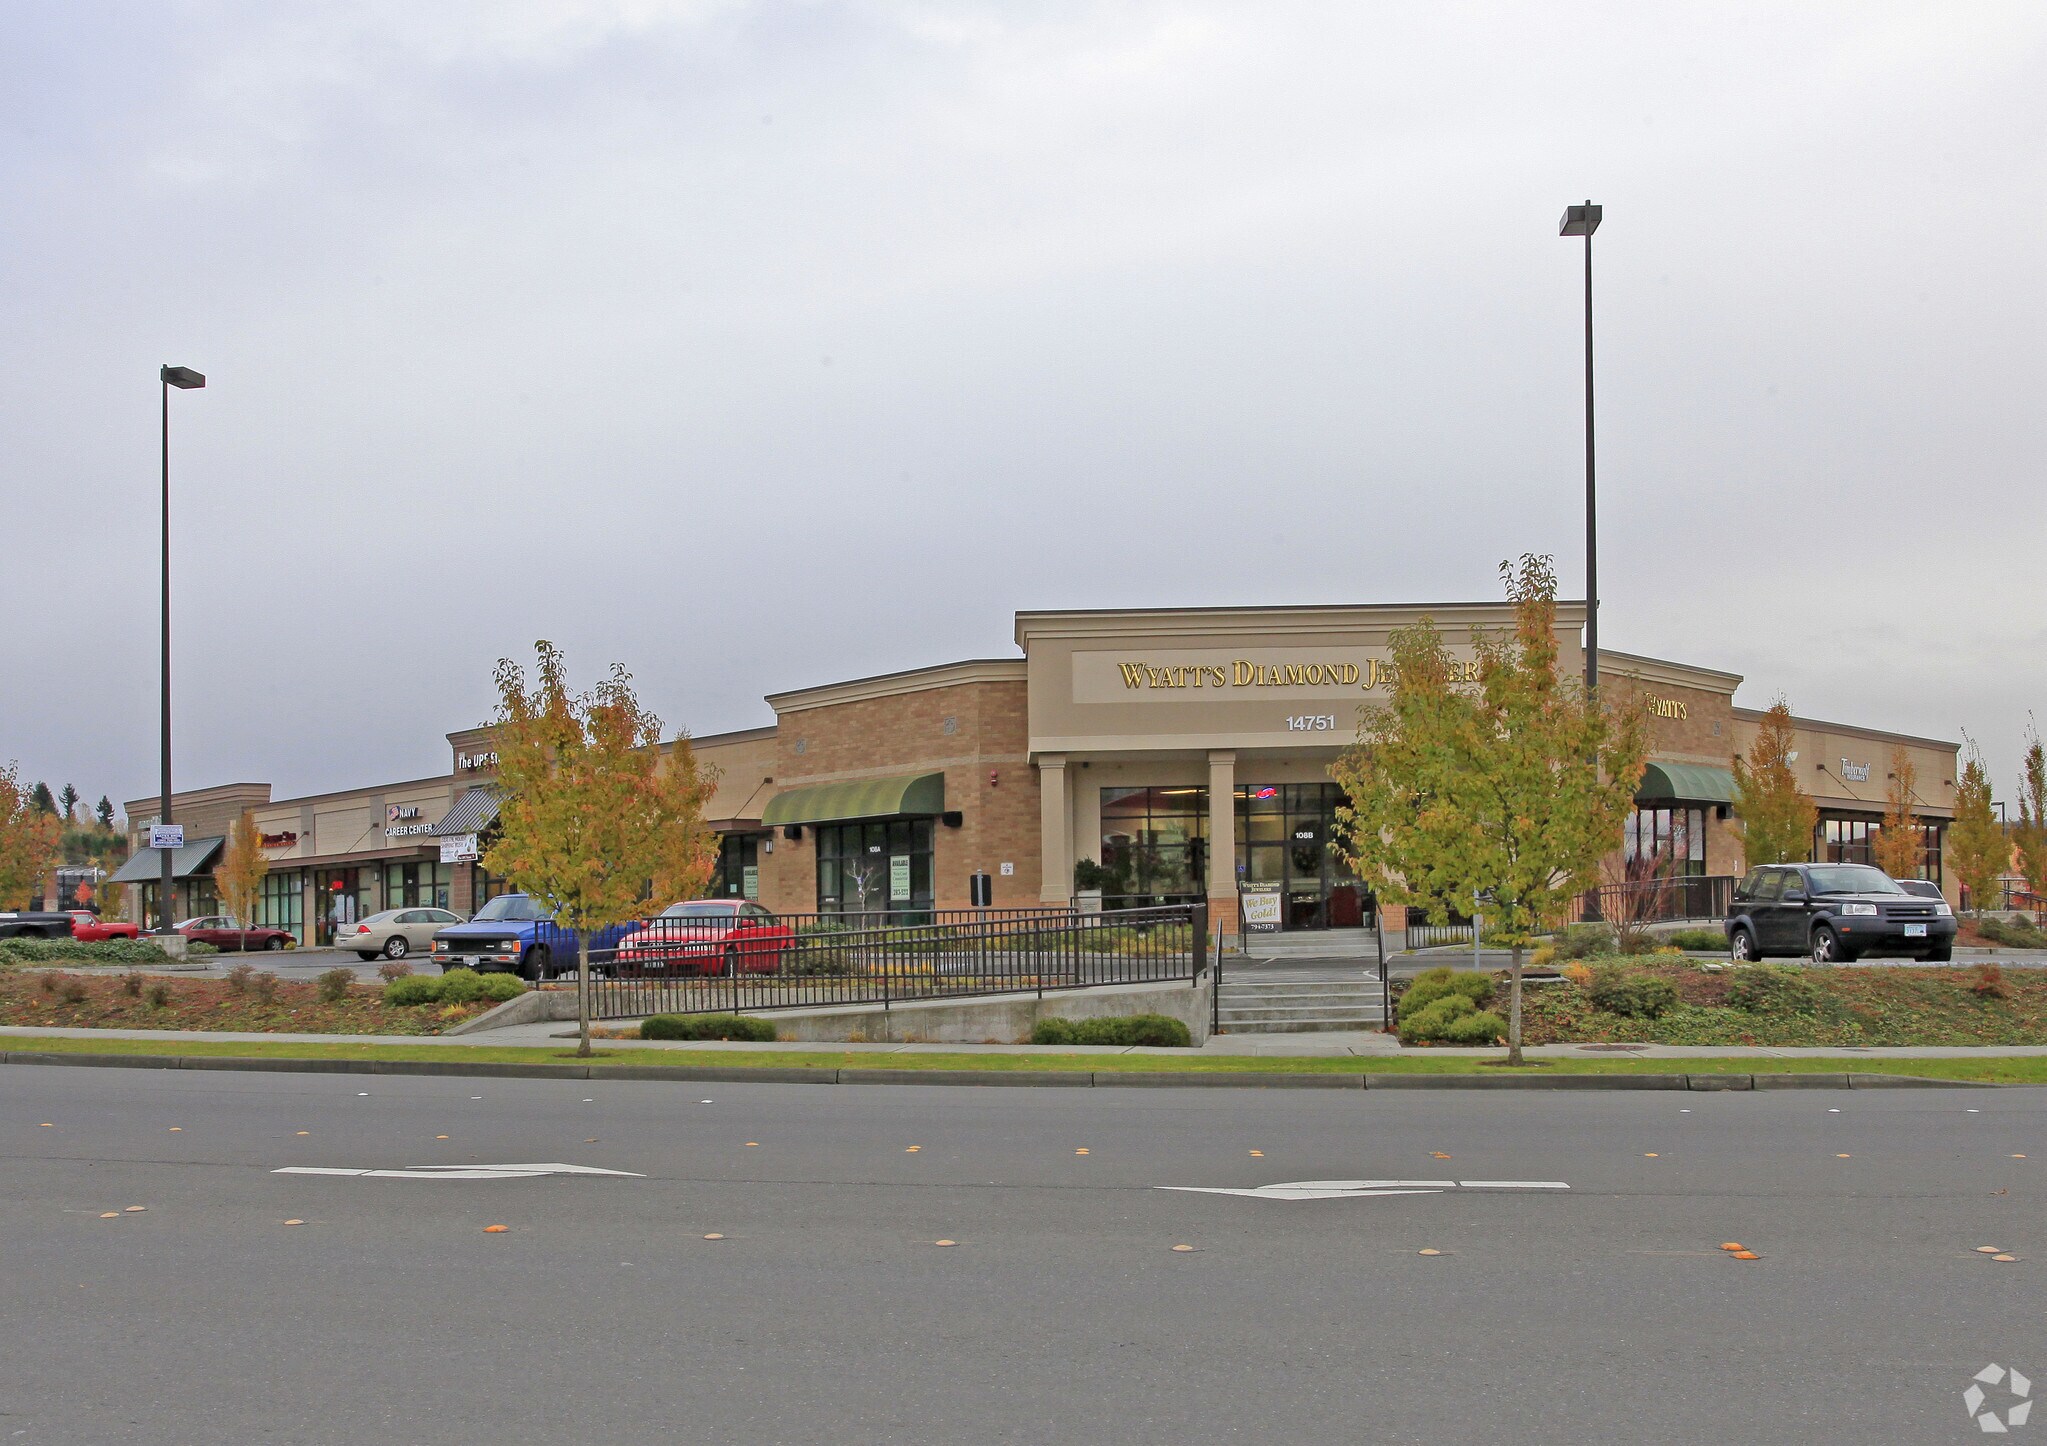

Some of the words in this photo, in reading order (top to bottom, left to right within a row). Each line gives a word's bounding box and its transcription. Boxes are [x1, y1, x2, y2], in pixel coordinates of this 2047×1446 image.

[1117, 661, 1226, 689] WYATT'S
[1232, 659, 1360, 688] DIAMOND
[1362, 657, 1482, 691] JEER
[1286, 714, 1336, 732] 14751
[458, 755, 472, 769] The
[399, 807, 418, 819] NAVY
[385, 825, 408, 837] CAREER
[408, 823, 434, 835] CENTER
[1295, 831, 1314, 839] 108B
[1246, 898, 1258, 908] We
[1259, 896, 1277, 907] Buy
[1251, 907, 1277, 920] Gold!
